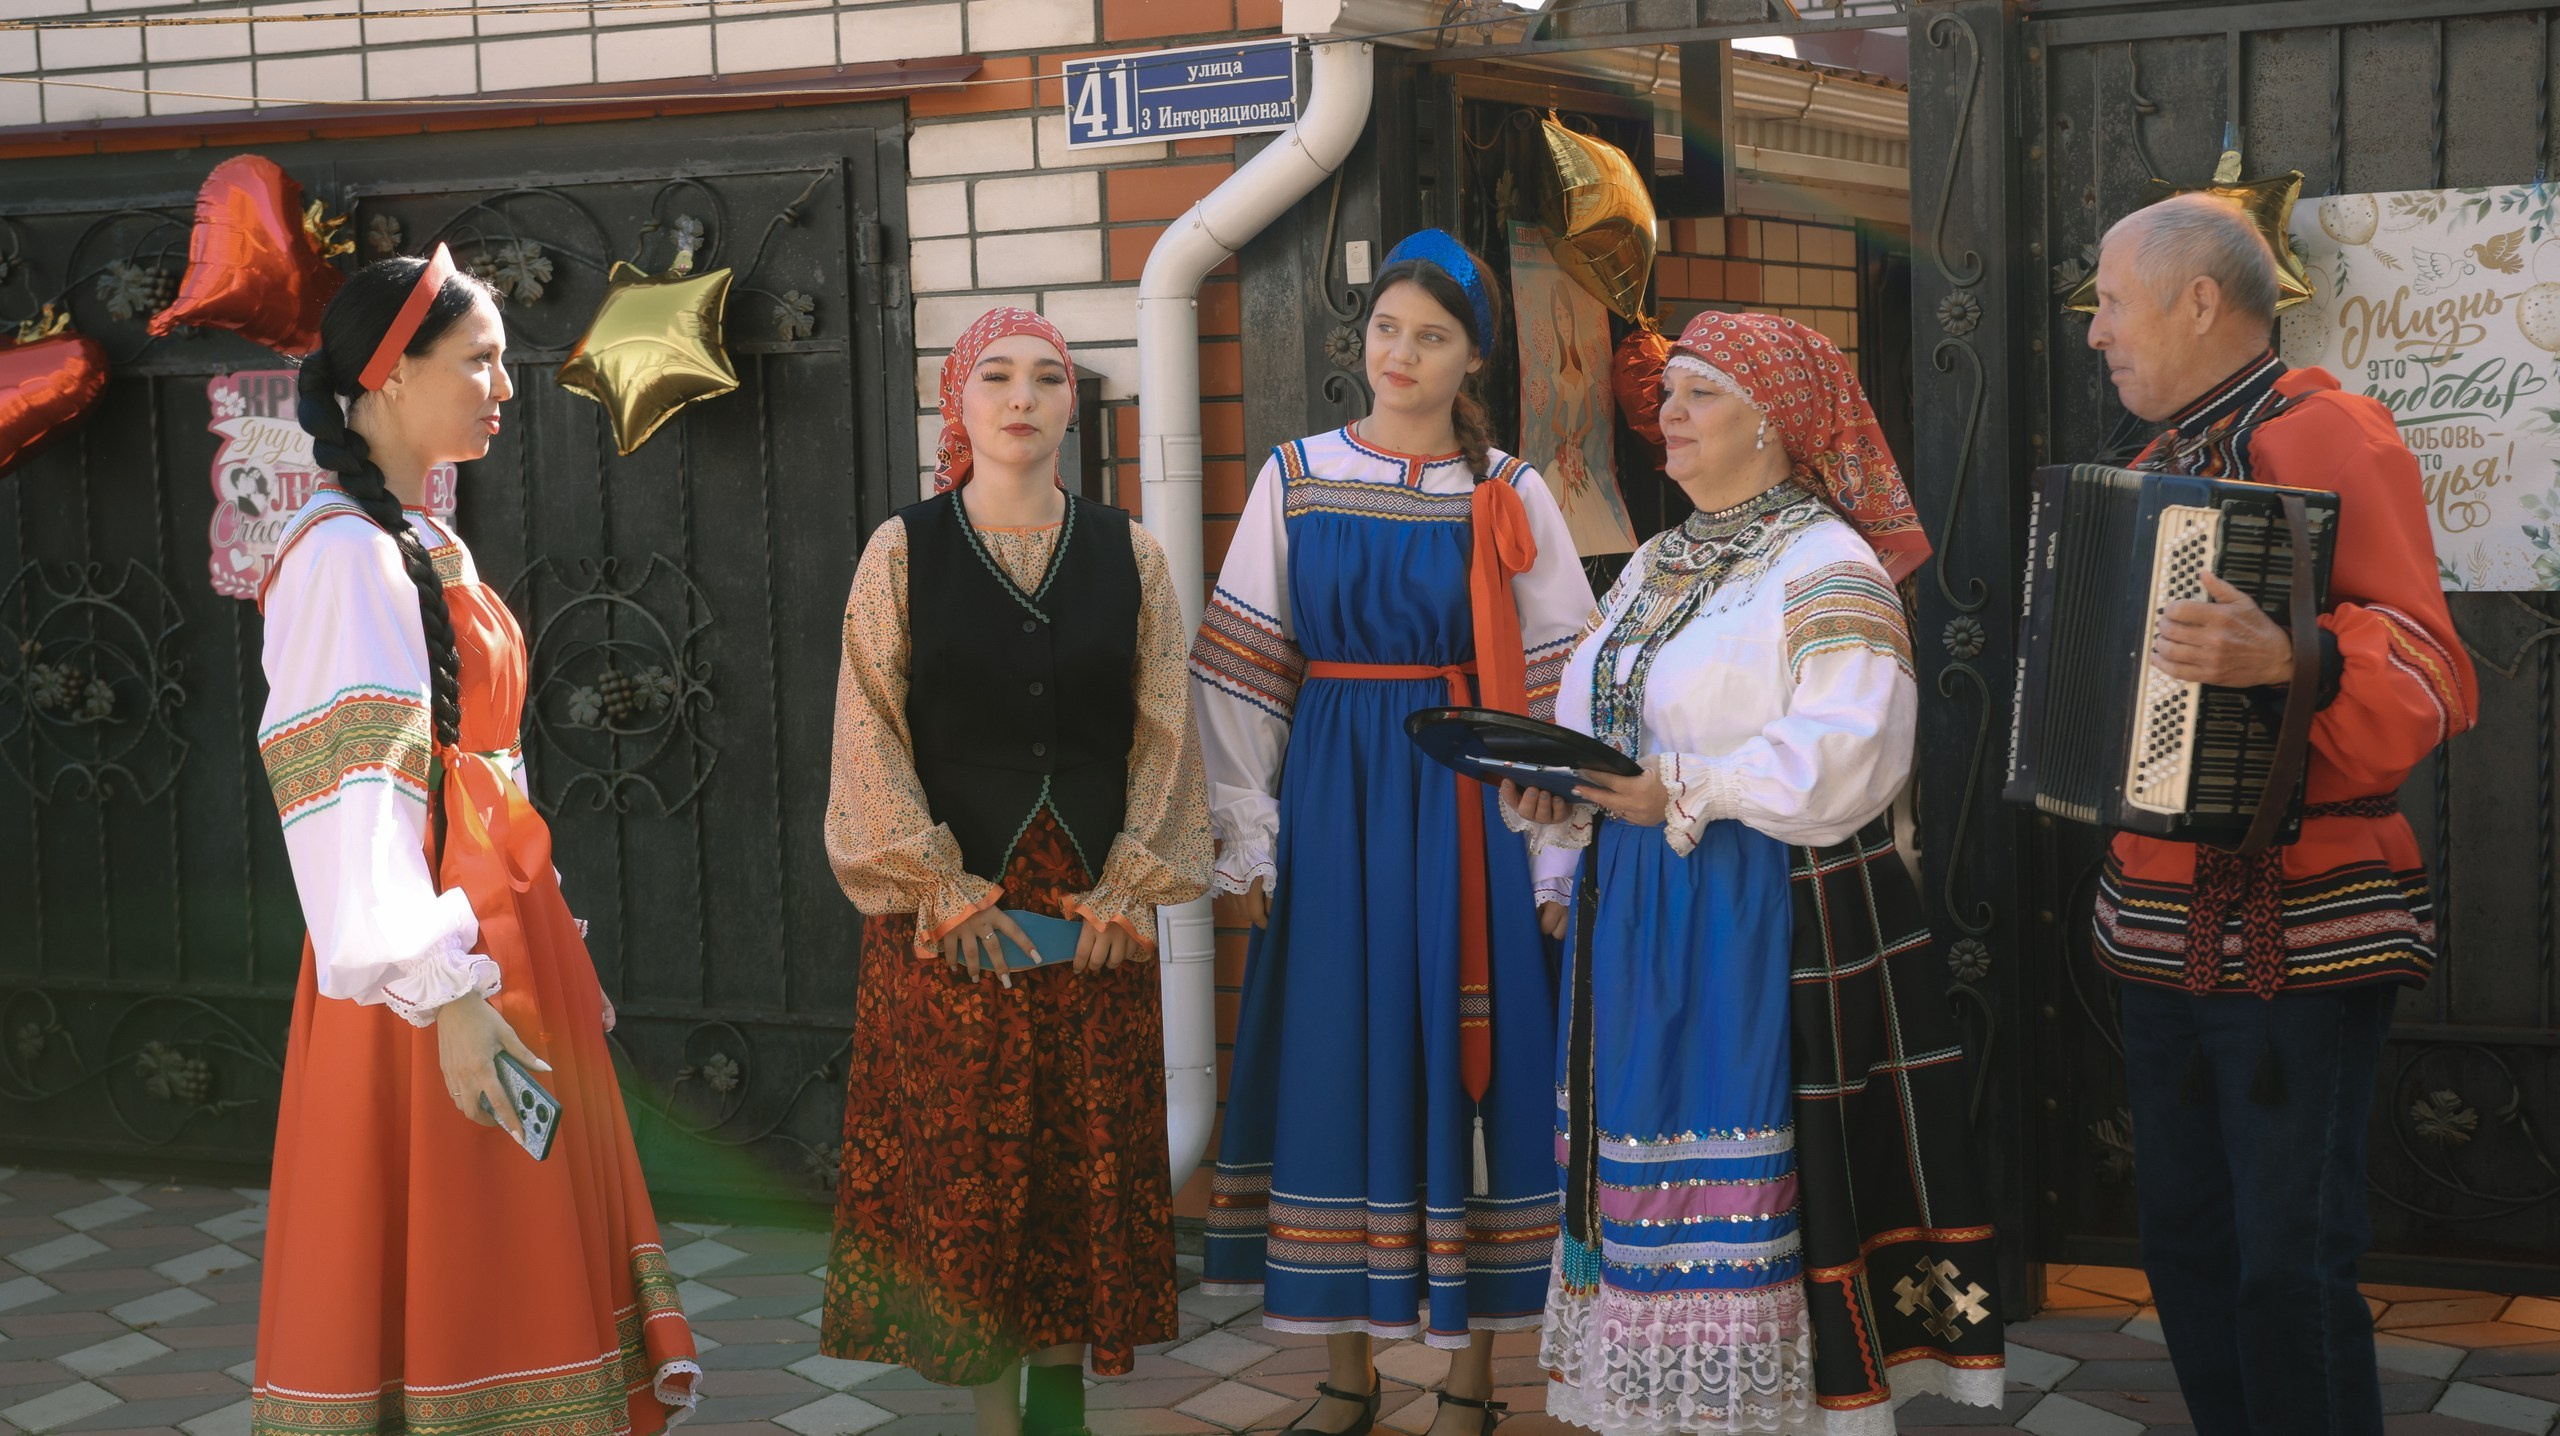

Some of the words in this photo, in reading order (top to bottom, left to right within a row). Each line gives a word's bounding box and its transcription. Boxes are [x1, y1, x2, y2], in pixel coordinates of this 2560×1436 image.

[1187, 60, 1243, 82] улица
[1073, 64, 1134, 138] 41
[1142, 108, 1152, 130] 3
[1158, 100, 1291, 130] Интернационал
[2368, 359, 2407, 380] ЭТО
[2403, 426, 2504, 450] ЮБОВЬ-
